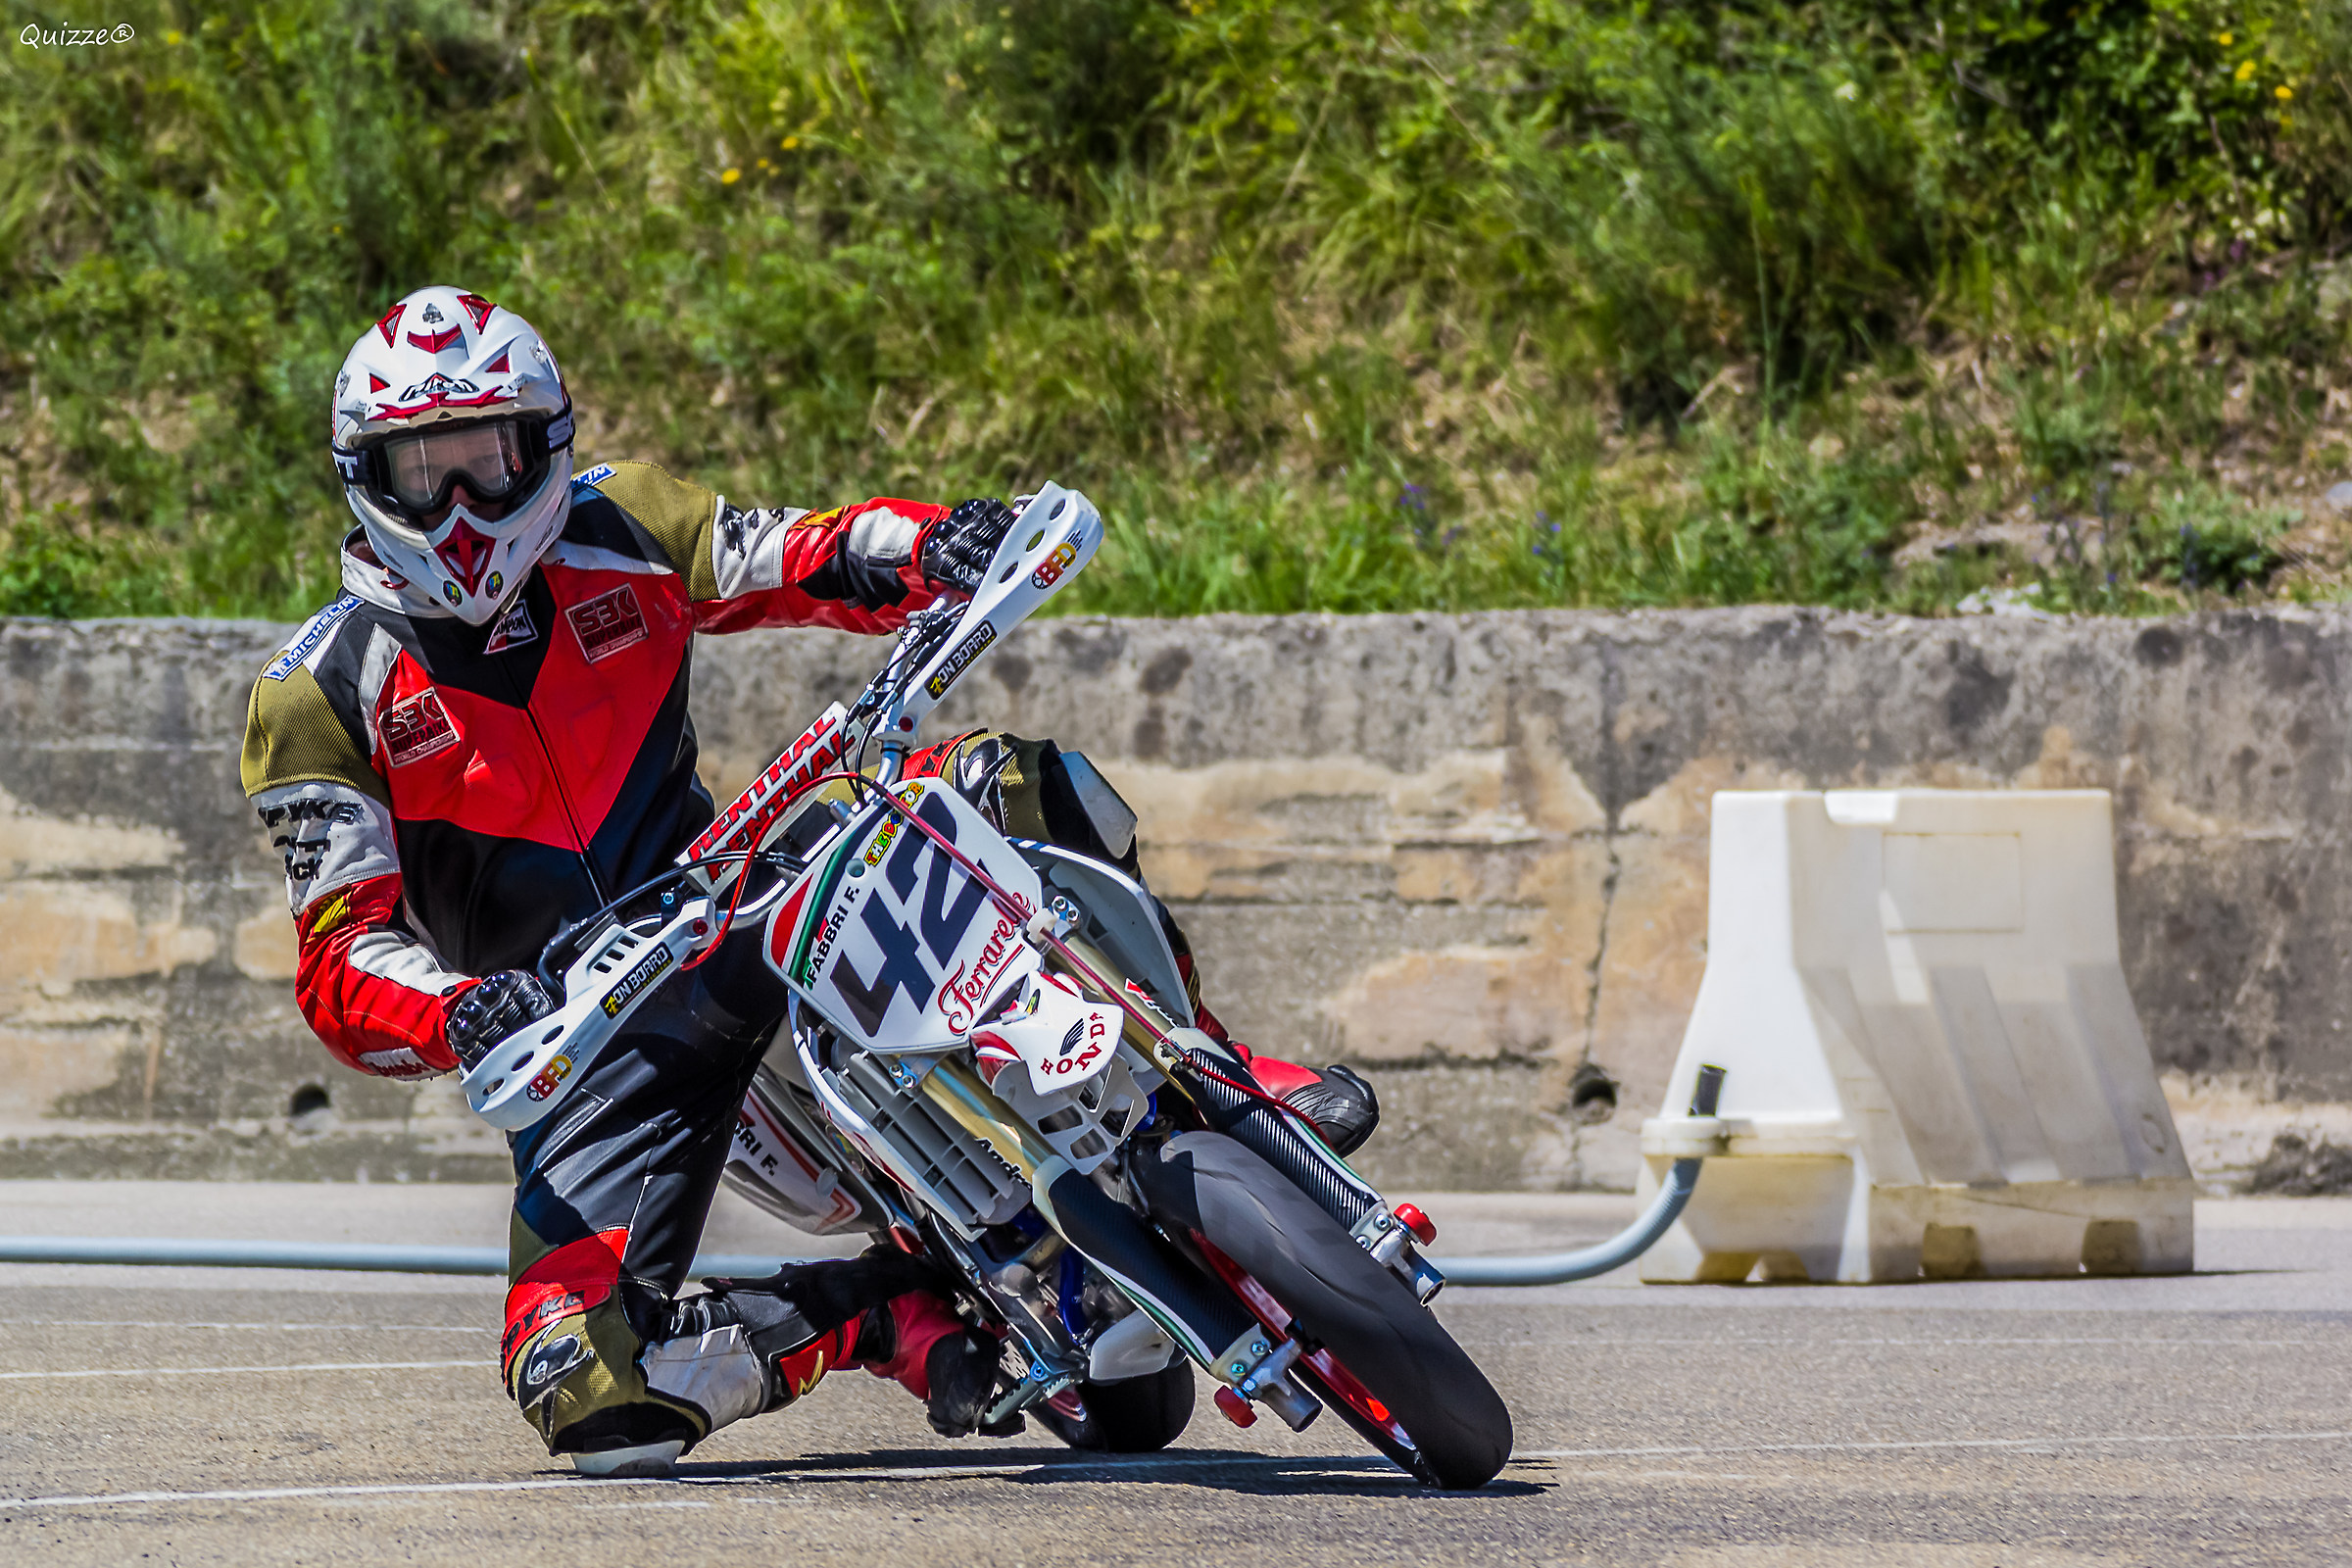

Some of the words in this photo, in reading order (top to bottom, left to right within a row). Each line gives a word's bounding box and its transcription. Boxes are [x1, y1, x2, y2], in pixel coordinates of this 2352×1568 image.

[288, 597, 355, 663] MICHELIN
[937, 661, 956, 683] ON
[952, 623, 993, 667] BOARD
[687, 717, 836, 861] RENTHAL
[863, 831, 891, 867] THE
[882, 781, 925, 838] DOTOR
[805, 904, 849, 984] FABBRI
[844, 886, 859, 904] F.
[829, 791, 998, 1038] 42
[612, 981, 632, 1004] ON
[627, 946, 668, 990] BOARD
[938, 892, 1037, 1036] Ferrarele
[1040, 1012, 1105, 1075] HONDA
